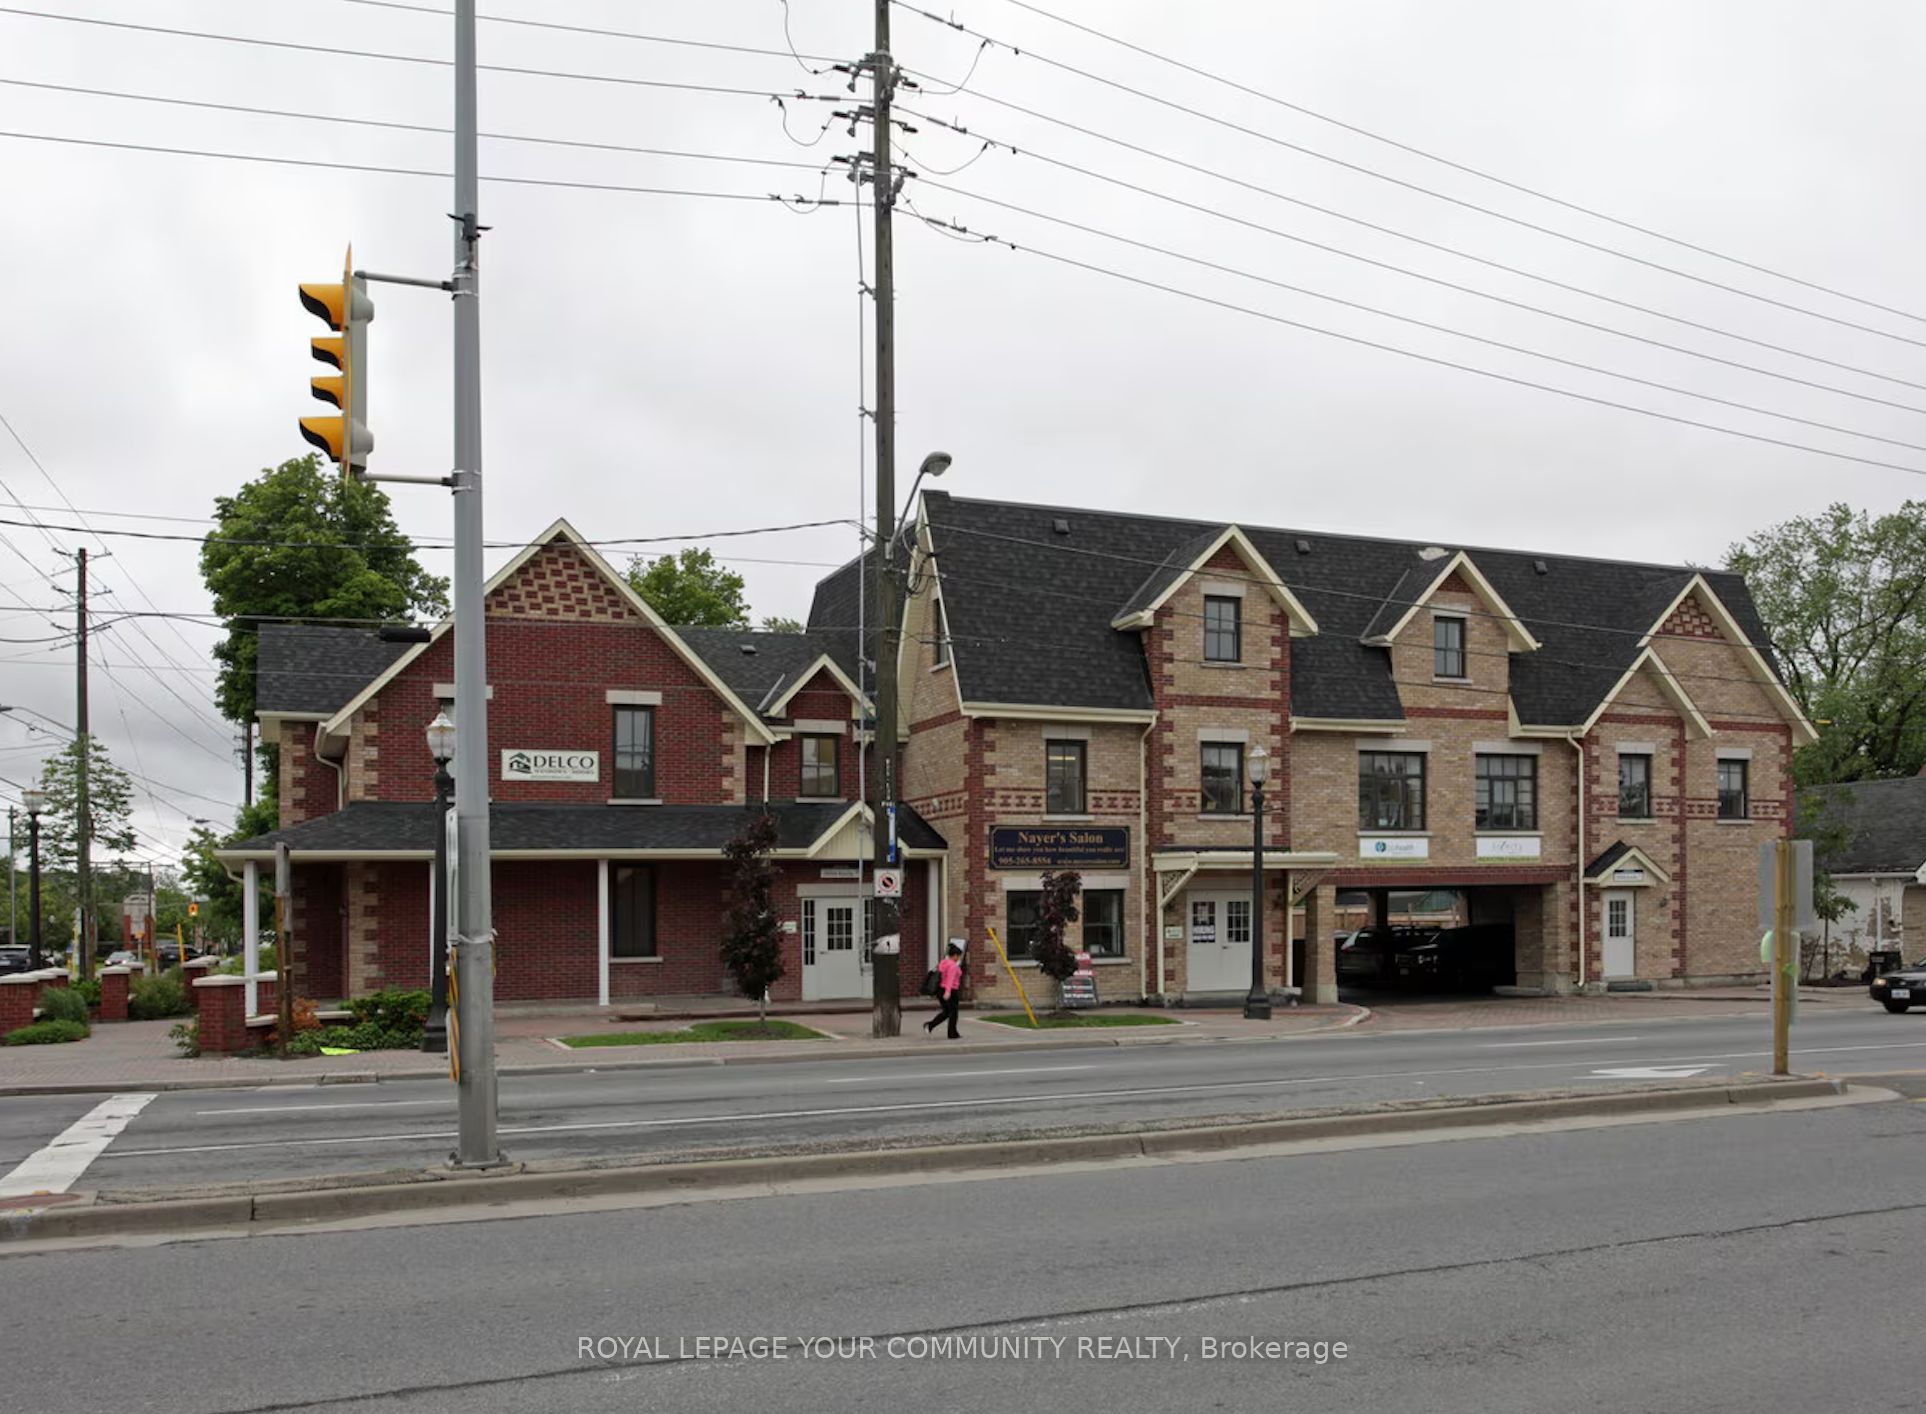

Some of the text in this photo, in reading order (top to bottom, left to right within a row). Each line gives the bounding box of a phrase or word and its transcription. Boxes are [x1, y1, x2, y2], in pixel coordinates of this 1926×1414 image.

[533, 756, 594, 769] DELCO
[1018, 831, 1104, 846] Nayer's Salon
